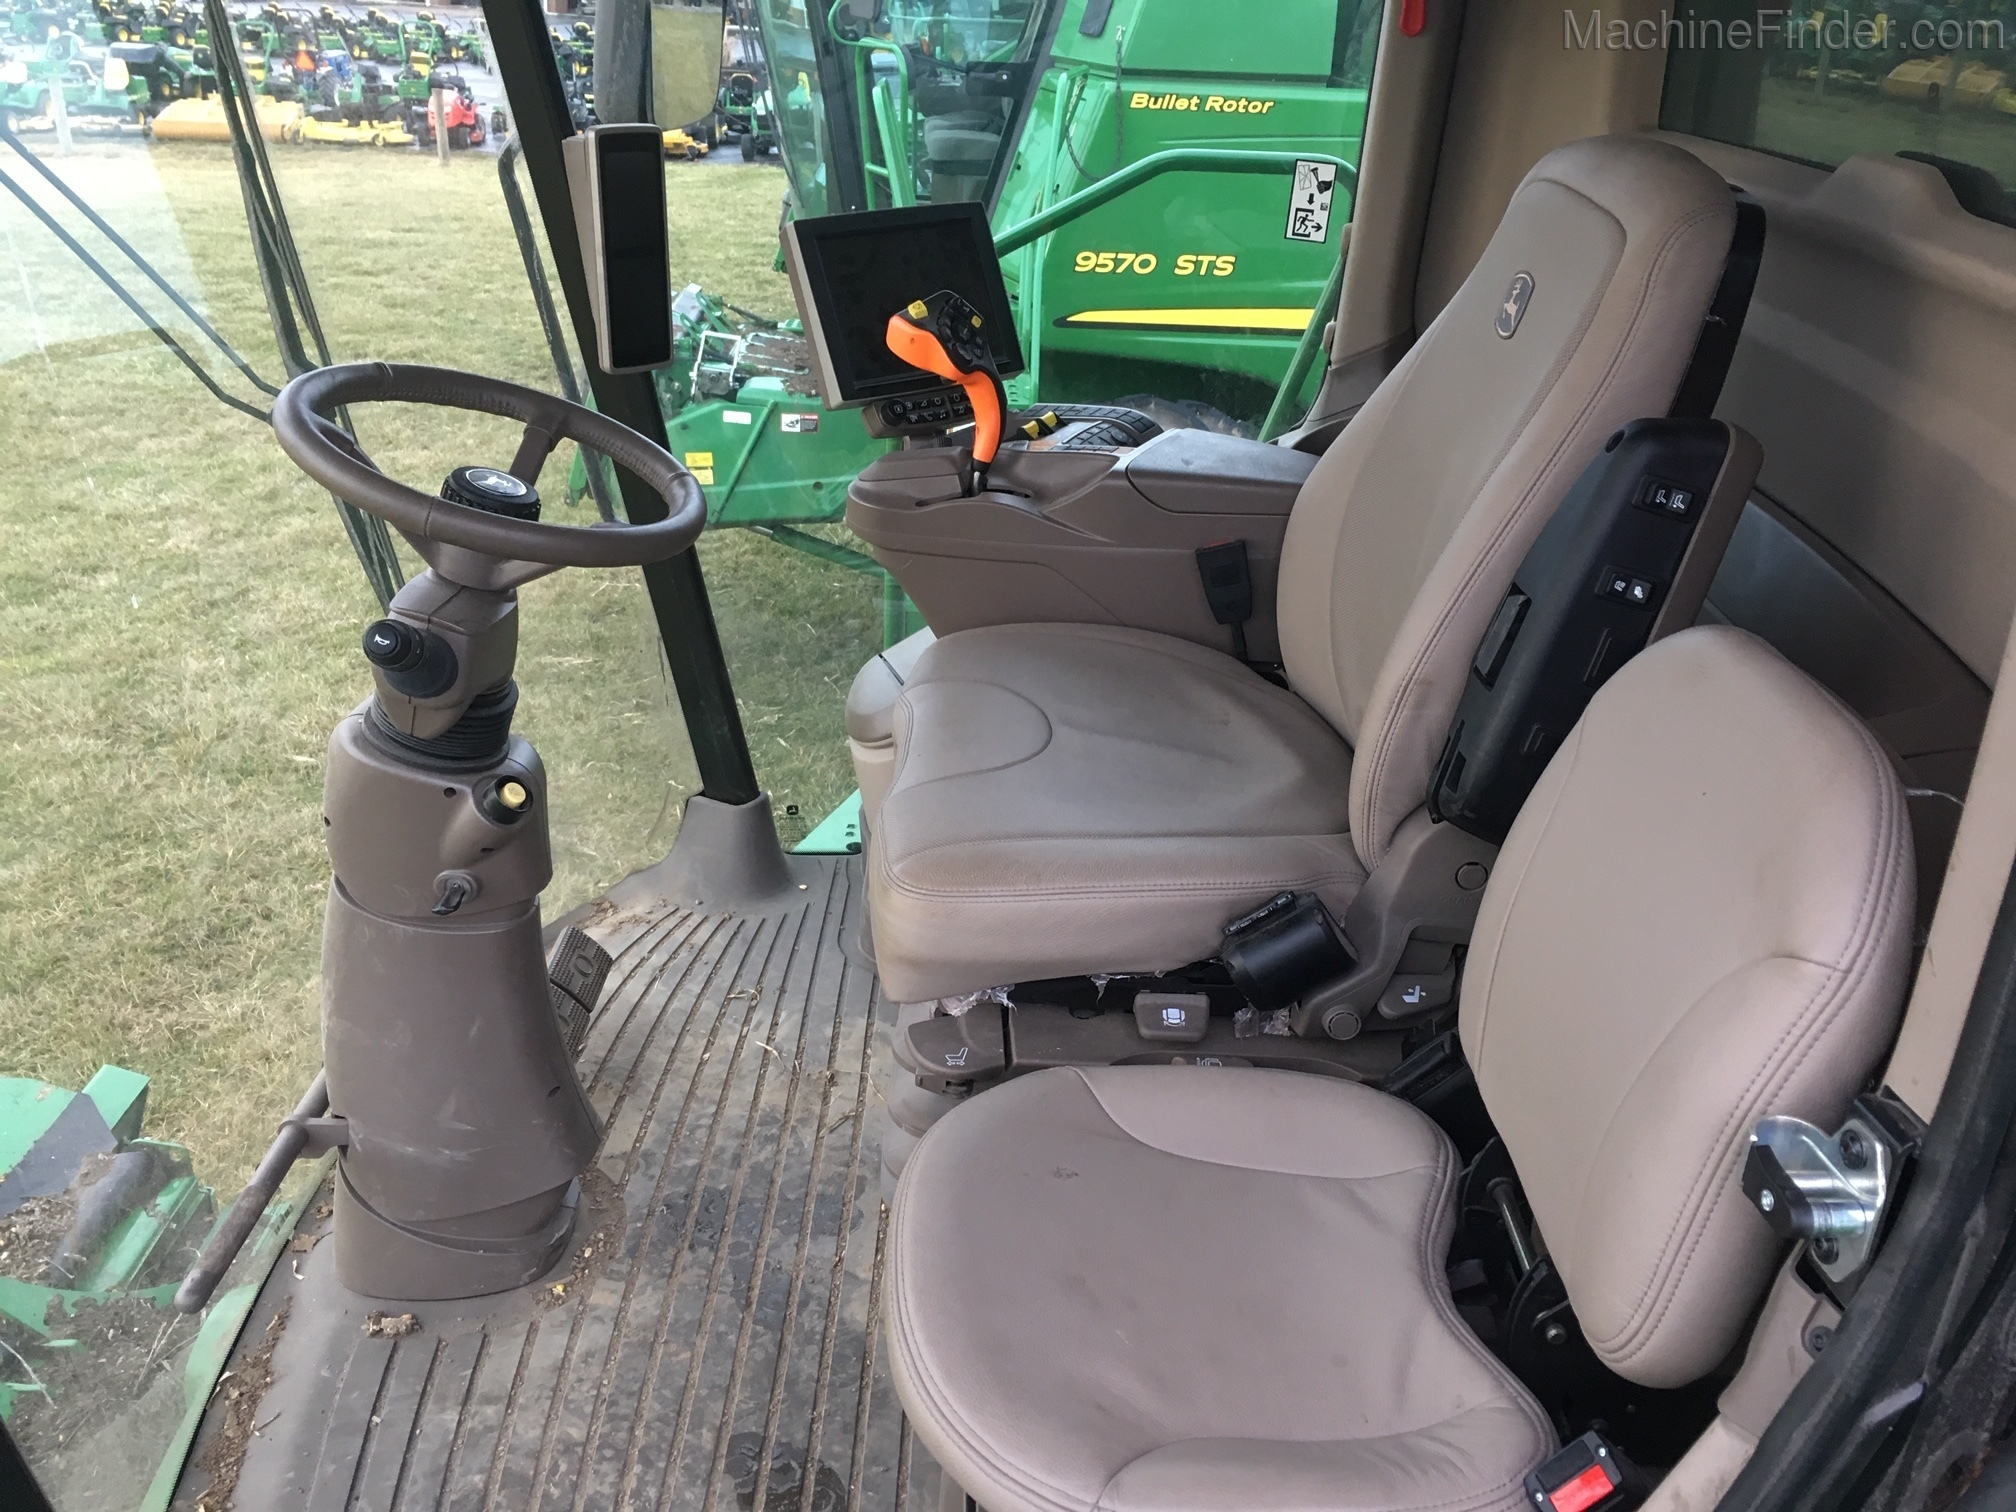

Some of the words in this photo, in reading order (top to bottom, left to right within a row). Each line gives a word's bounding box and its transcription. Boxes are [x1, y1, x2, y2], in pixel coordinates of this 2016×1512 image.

[1130, 93, 1200, 111] Bullet
[1204, 96, 1274, 114] Rotor
[1074, 251, 1158, 275] 9570
[1173, 254, 1236, 276] STS
